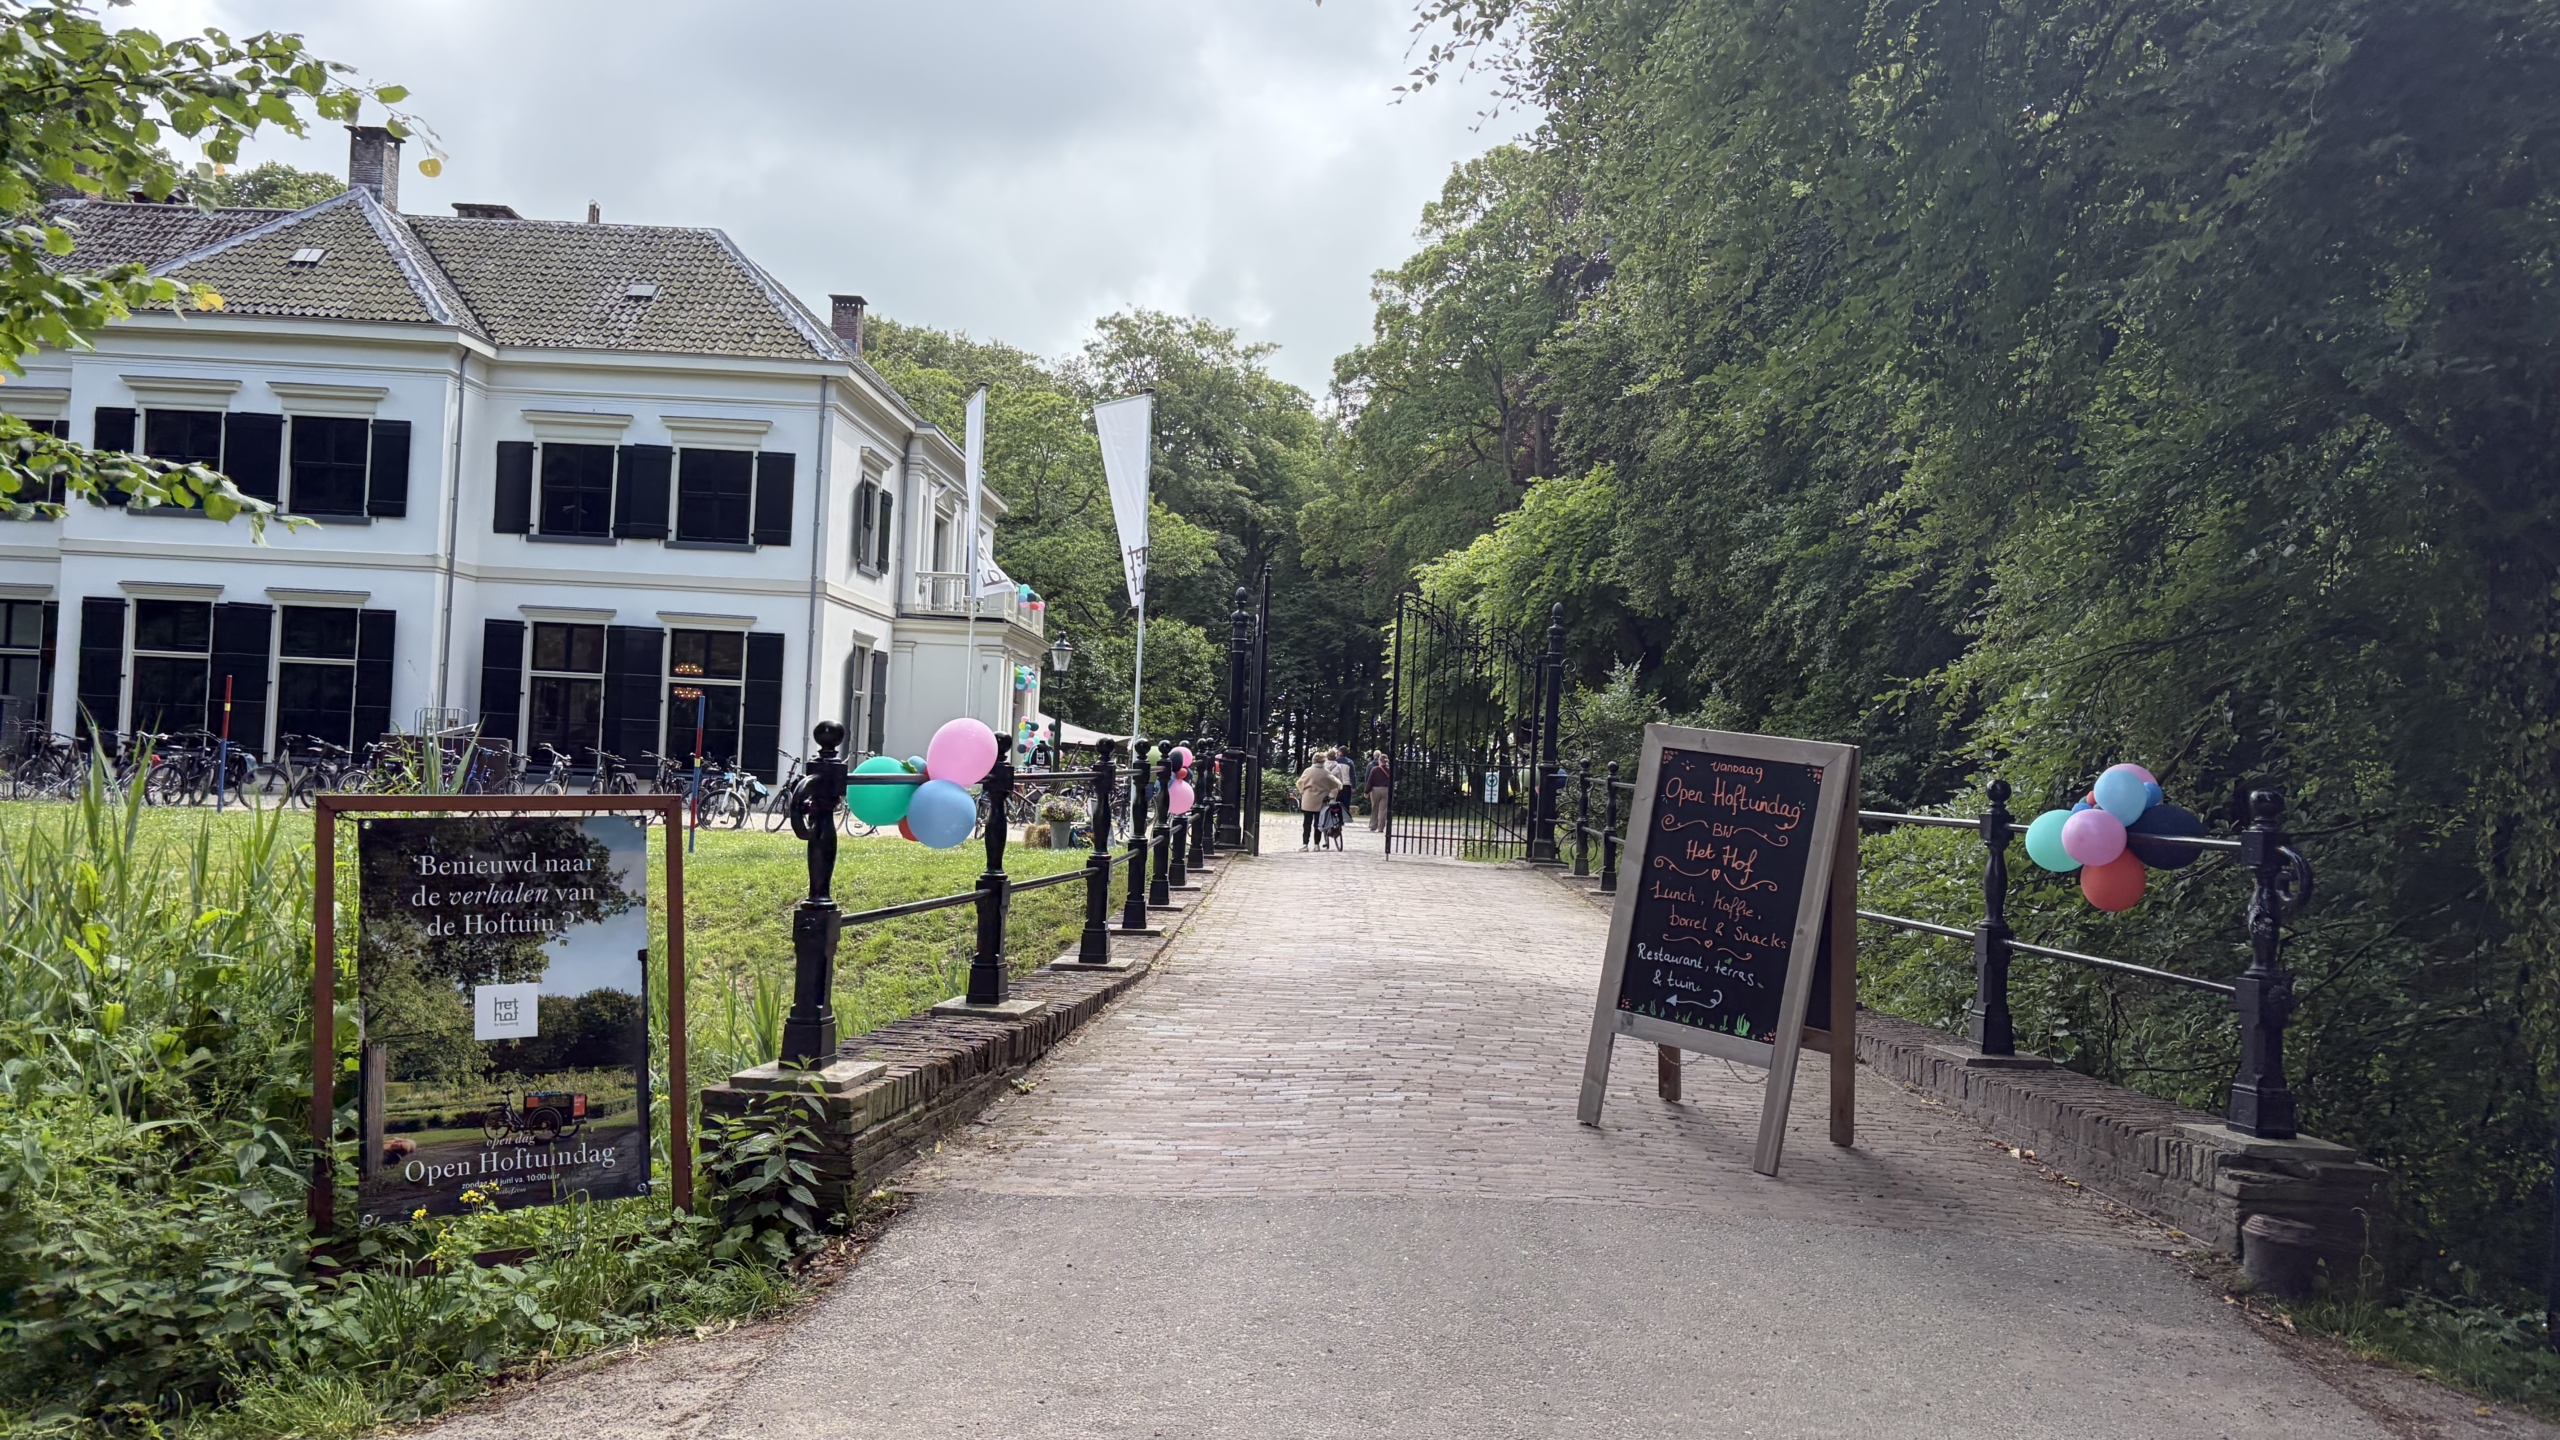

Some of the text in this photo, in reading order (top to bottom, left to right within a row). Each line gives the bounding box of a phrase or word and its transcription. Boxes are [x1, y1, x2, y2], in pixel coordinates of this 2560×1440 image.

[1665, 777, 1801, 831] Open Hoftuindag
[545, 857, 596, 873] naar
[1686, 840, 1758, 885] Het Hof
[411, 882, 595, 907] de verhalen van
[427, 915, 456, 937] de
[464, 912, 554, 935] Hoftuin
[1715, 922, 1725, 936] &
[1734, 926, 1786, 949] Snacks
[1637, 942, 1754, 987] Restaurant, terras
[1652, 969, 1662, 986] &
[486, 1133, 536, 1149] open dag
[405, 1142, 616, 1186] Open Hoftuindag
[499, 1177, 514, 1187] juni
[527, 1173, 547, 1182] 10:00
